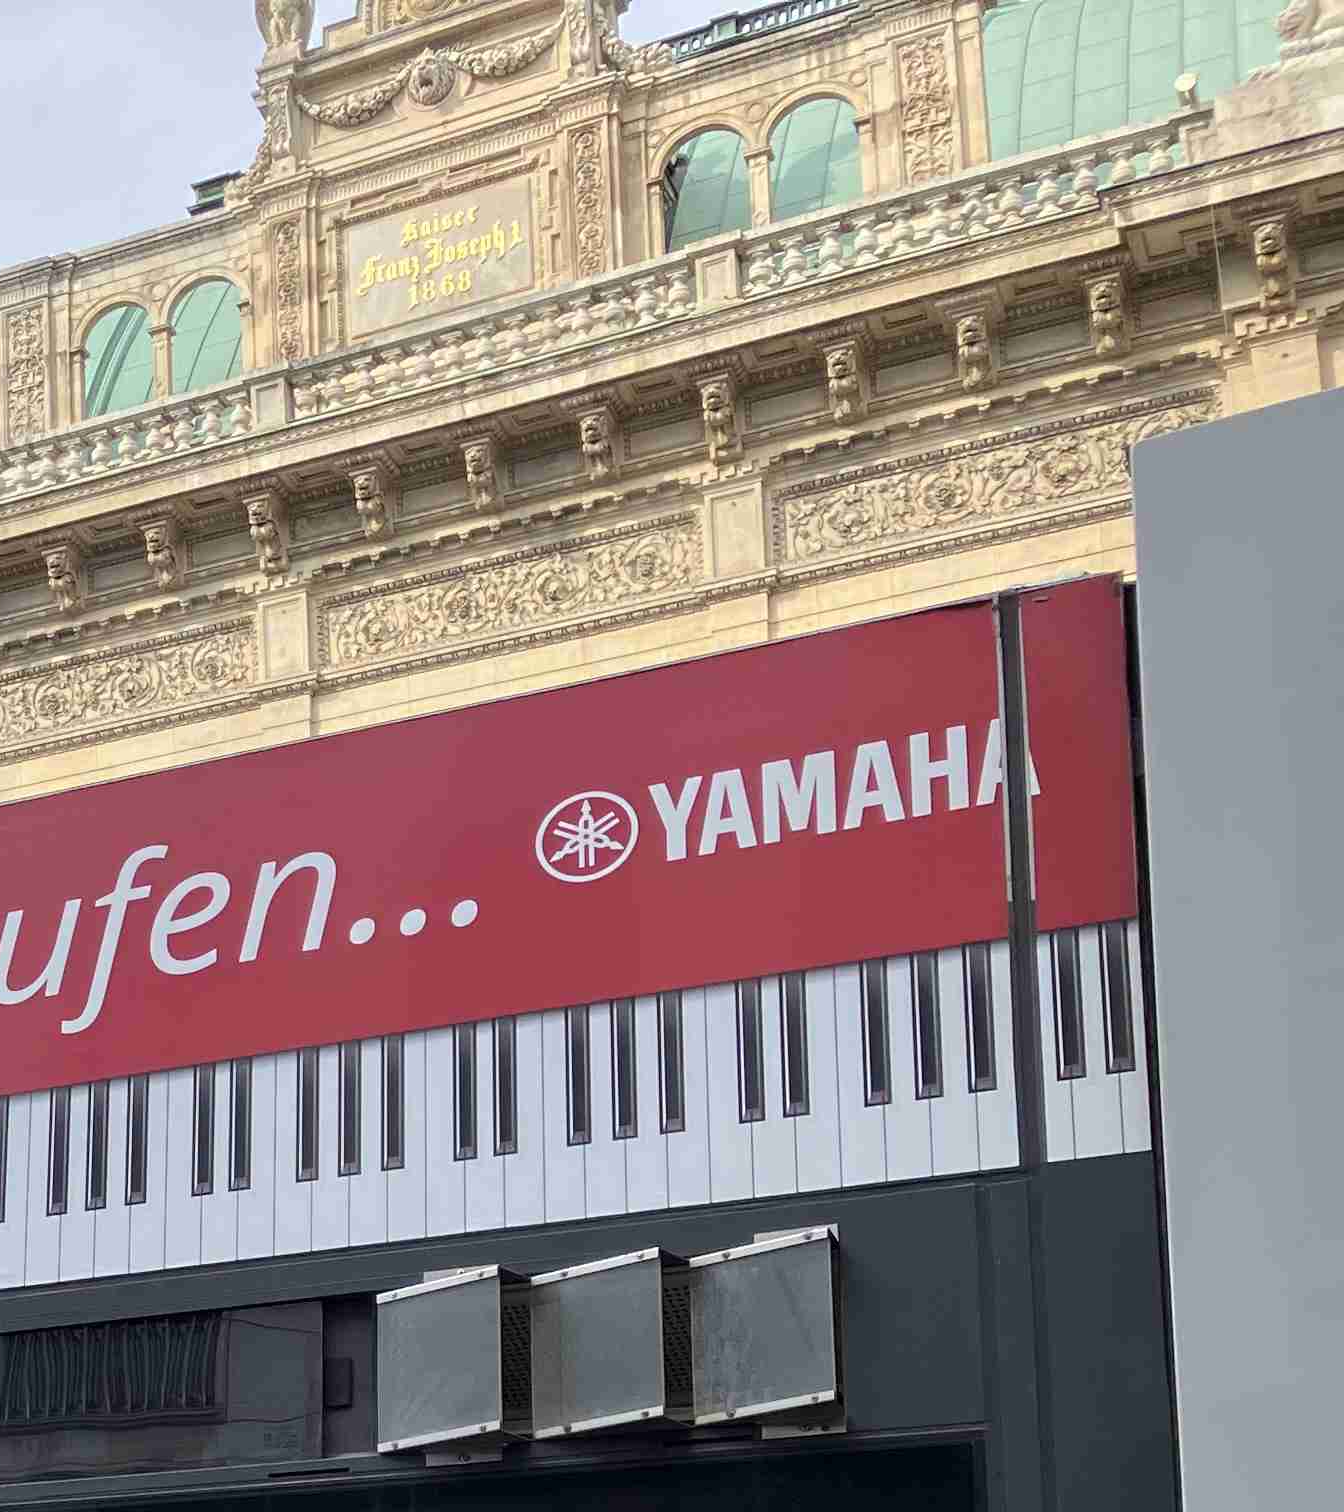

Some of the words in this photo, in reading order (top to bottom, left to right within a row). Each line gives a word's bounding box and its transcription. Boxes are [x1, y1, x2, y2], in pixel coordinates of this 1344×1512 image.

[400, 205, 480, 247] Kaiser
[356, 253, 421, 296] Franz
[423, 219, 506, 274] Joseph
[408, 270, 473, 311] 1868
